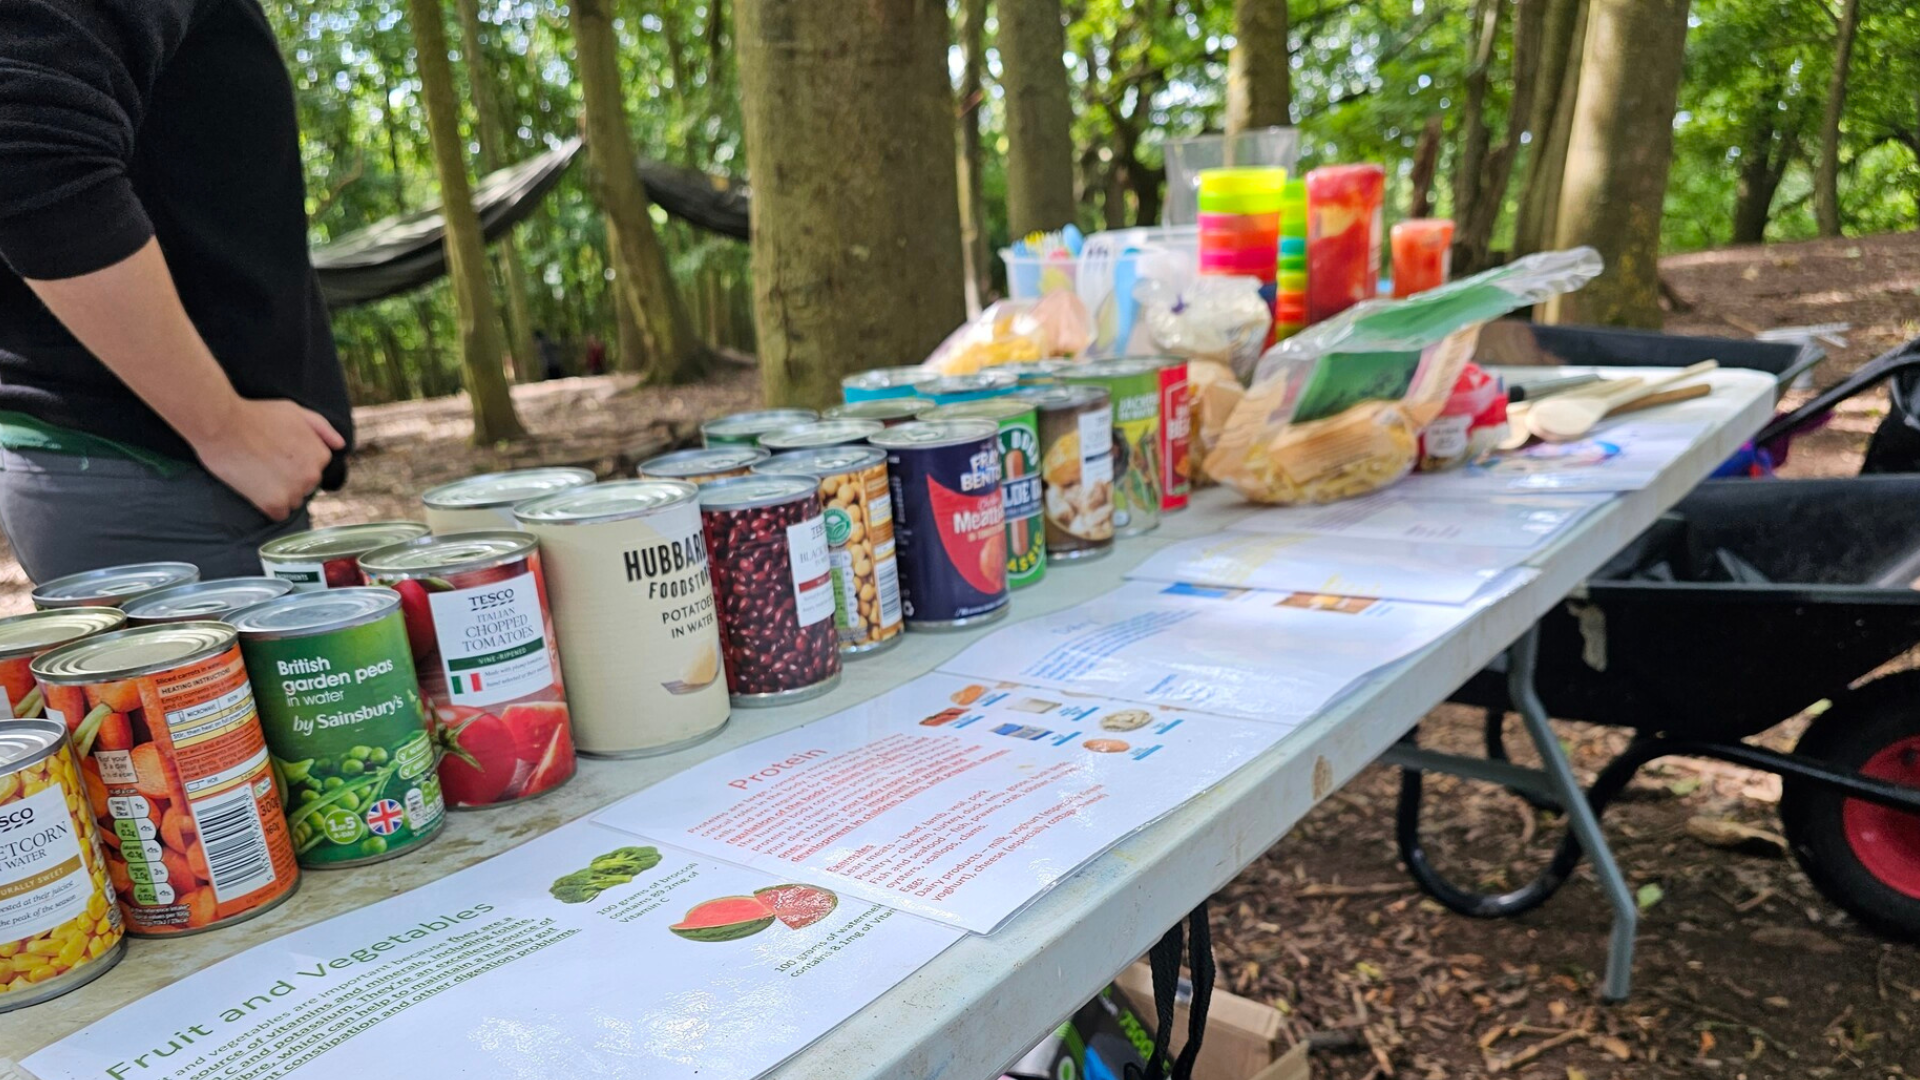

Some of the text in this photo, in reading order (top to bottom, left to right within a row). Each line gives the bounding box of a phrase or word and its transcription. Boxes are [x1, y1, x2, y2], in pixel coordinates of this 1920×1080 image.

[960, 466, 1002, 492] BENTO
[468, 588, 514, 607] TESCO
[649, 566, 710, 600] FOODSTO
[465, 614, 528, 638] CHOPPED
[477, 607, 516, 623] ITALIAN
[662, 594, 713, 624] POTATOES
[672, 613, 713, 639] IN WATER
[462, 626, 534, 652] TOMATOES
[478, 646, 527, 664] VINE-RIPENED
[162, 680, 192, 694] HEATING
[277, 656, 330, 676] British
[282, 659, 394, 696] garden peas
[286, 688, 344, 708] in water
[293, 695, 404, 736] by Sainsbury's
[728, 750, 828, 790] Protein
[0, 808, 34, 828] SCO
[687, 812, 728, 833] Proteins
[701, 806, 756, 836] critical roles
[713, 788, 808, 840] cells and are required
[726, 816, 775, 843] regulation
[785, 801, 803, 810] the
[737, 787, 848, 846] the human body contains
[751, 831, 786, 851] protein
[802, 807, 827, 821] chain
[839, 787, 865, 801] amino
[763, 841, 785, 854] your
[787, 830, 805, 841] diet
[815, 812, 838, 822] help
[777, 807, 866, 858] ones. Protein also
[791, 799, 902, 861] development children,
[0, 820, 68, 862] ETCORN
[5, 848, 47, 870] WATER
[826, 845, 874, 871] Examples
[840, 812, 950, 876] Lean meats beef, lamb,
[854, 815, 964, 879] Poultry chicken, turkey,
[868, 804, 1004, 884] Fish and seafood fish, prawns,
[886, 824, 987, 888] oysters, scallops, clams.
[914, 816, 1042, 896] Dairy products milk, yoghurt
[0, 867, 64, 896] URALLY SWEET
[596, 904, 618, 916] 100
[618, 889, 649, 906] grams
[659, 862, 699, 884] broccoli
[610, 897, 652, 920] contains
[688, 871, 700, 879] of
[898, 877, 926, 892] Eggs.
[932, 852, 1006, 900] yoghurt), cheese
[13, 912, 31, 924] peak
[33, 907, 42, 918] of
[42, 903, 54, 913] the
[774, 904, 884, 972] 100 grams of watermel
[791, 951, 833, 978] contains
[830, 931, 865, 951] 8.1mg
[862, 922, 874, 932] of
[106, 904, 494, 1080] Fruit and Vegetables
[175, 1056, 205, 1075] and
[209, 1013, 290, 1055] vegetables
[293, 998, 317, 1011] are
[319, 965, 390, 997] important
[391, 942, 446, 964] because
[447, 930, 478, 942] they
[480, 921, 501, 930] are
[191, 918, 534, 1080] source of vitamins and minerals, including folate,
[240, 1048, 270, 1067] and
[274, 1005, 356, 1048] potassium.
[357, 977, 411, 1001] They're
[415, 968, 433, 976] an
[435, 943, 494, 967] excellent
[496, 925, 538, 943] source
[277, 1033, 324, 1058] which
[328, 1017, 354, 1031] can
[355, 999, 390, 1015] help
[411, 962, 472, 989] maintain
[483, 938, 533, 957] healthy
[535, 927, 557, 938] gut
[284, 929, 578, 1070] constipation and other digestion problems.
